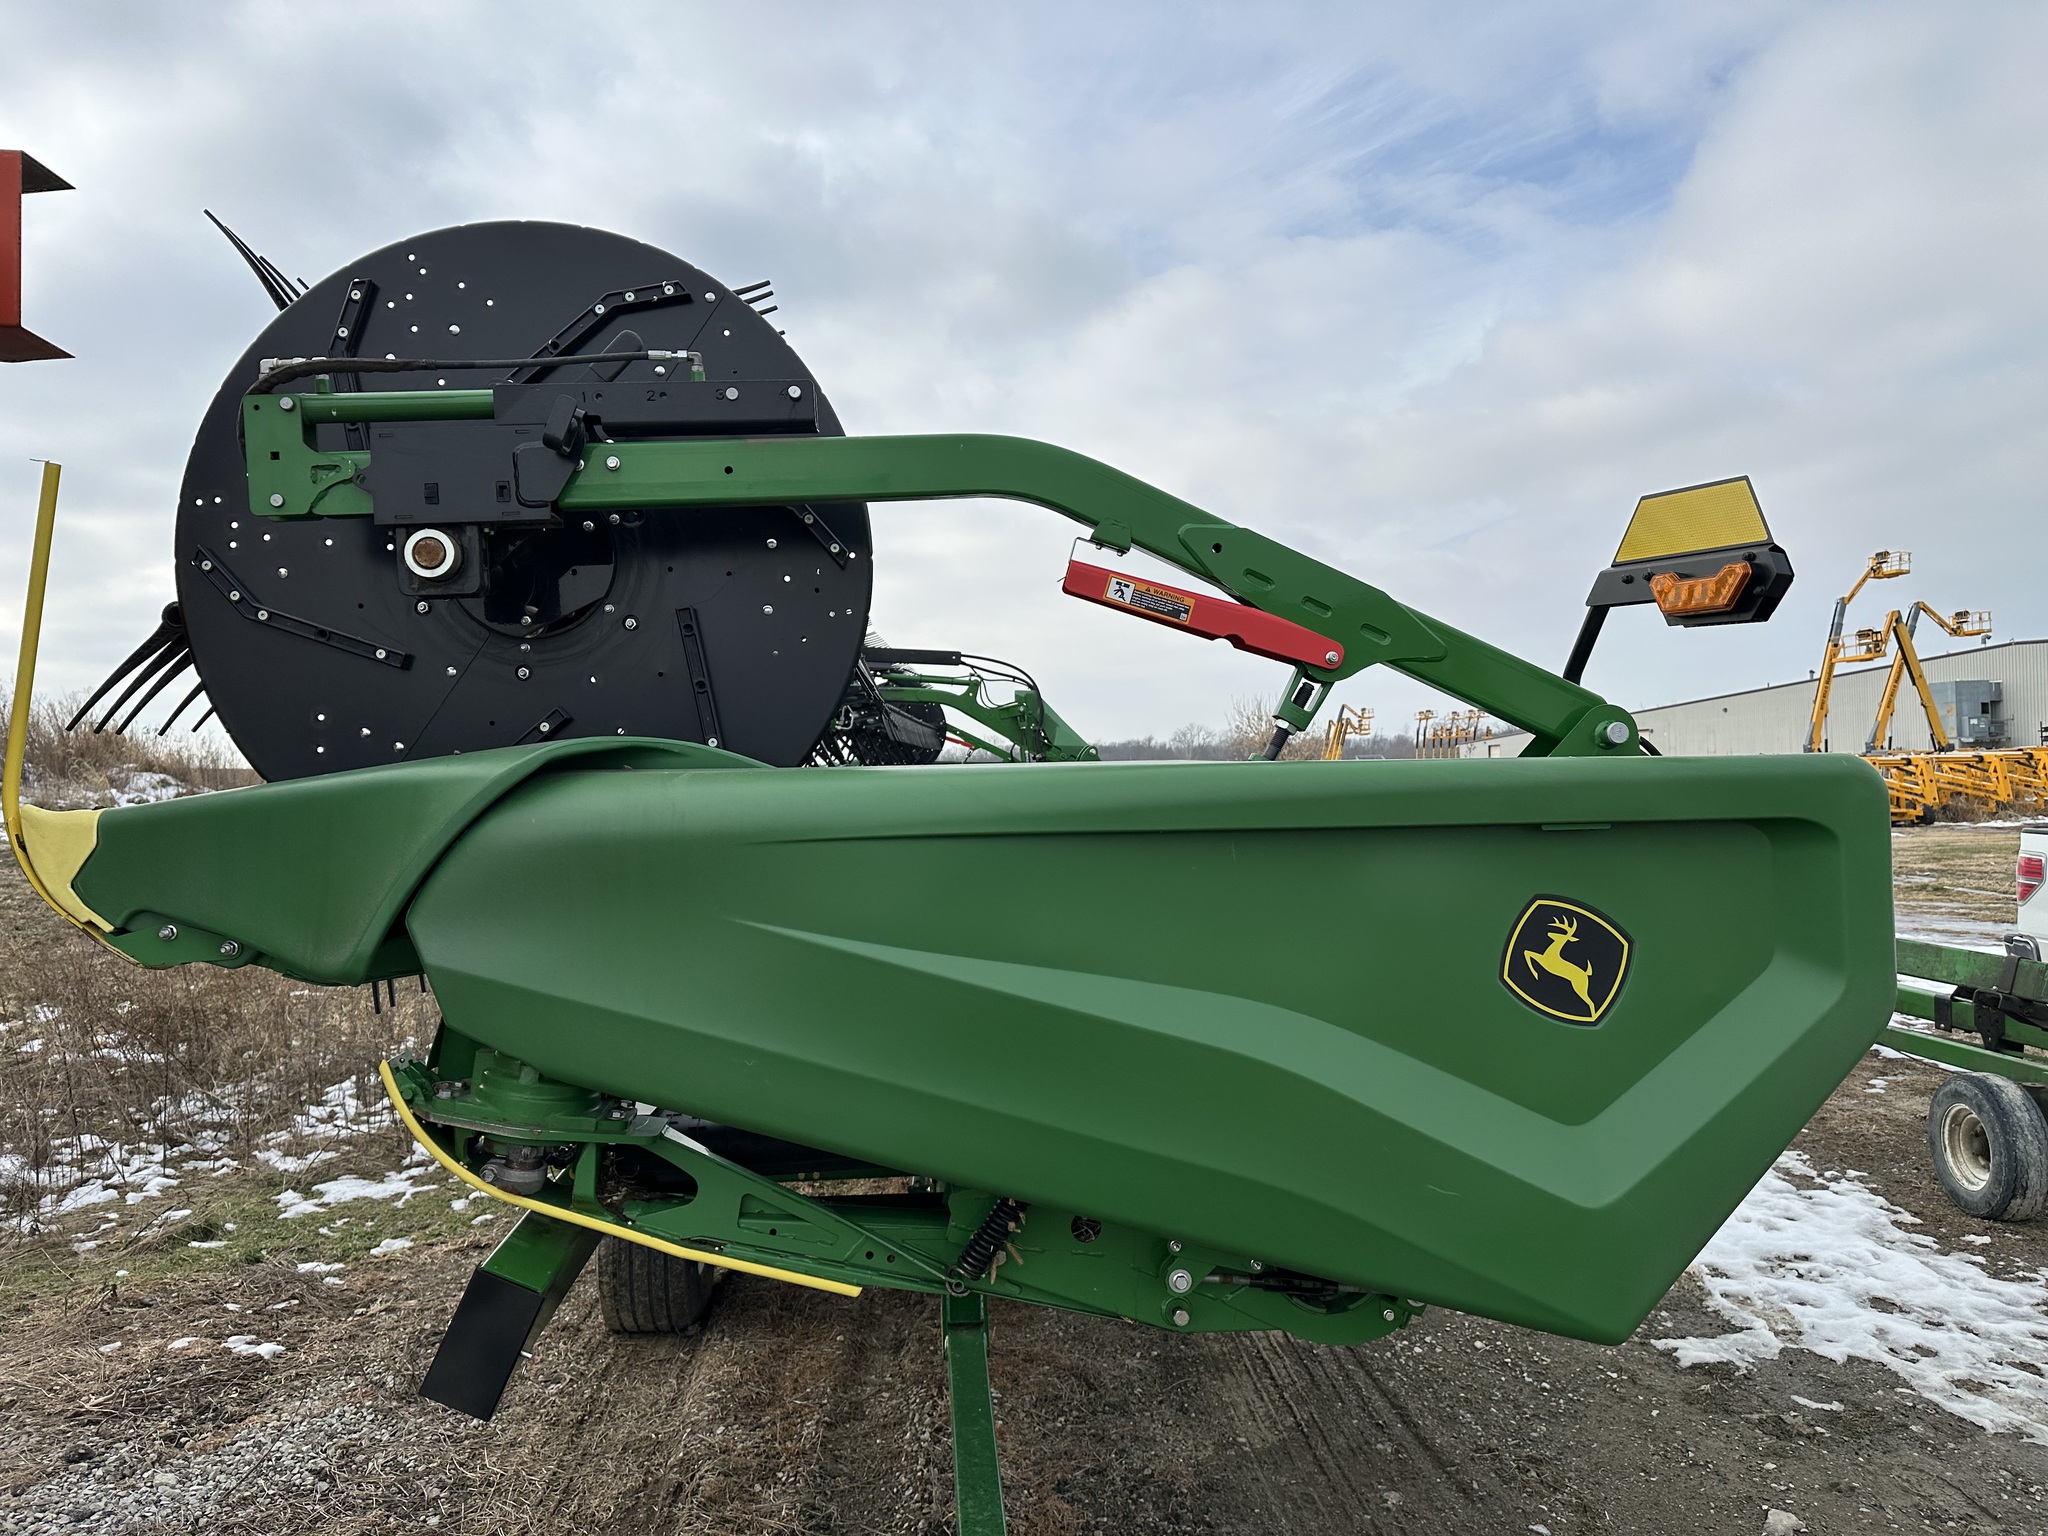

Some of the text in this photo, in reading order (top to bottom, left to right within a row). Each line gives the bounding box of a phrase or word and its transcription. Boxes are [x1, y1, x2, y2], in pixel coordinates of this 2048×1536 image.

[581, 391, 586, 403] 1
[646, 390, 656, 402] 2
[715, 389, 725, 400] 3
[1153, 588, 1185, 603] WARNING
